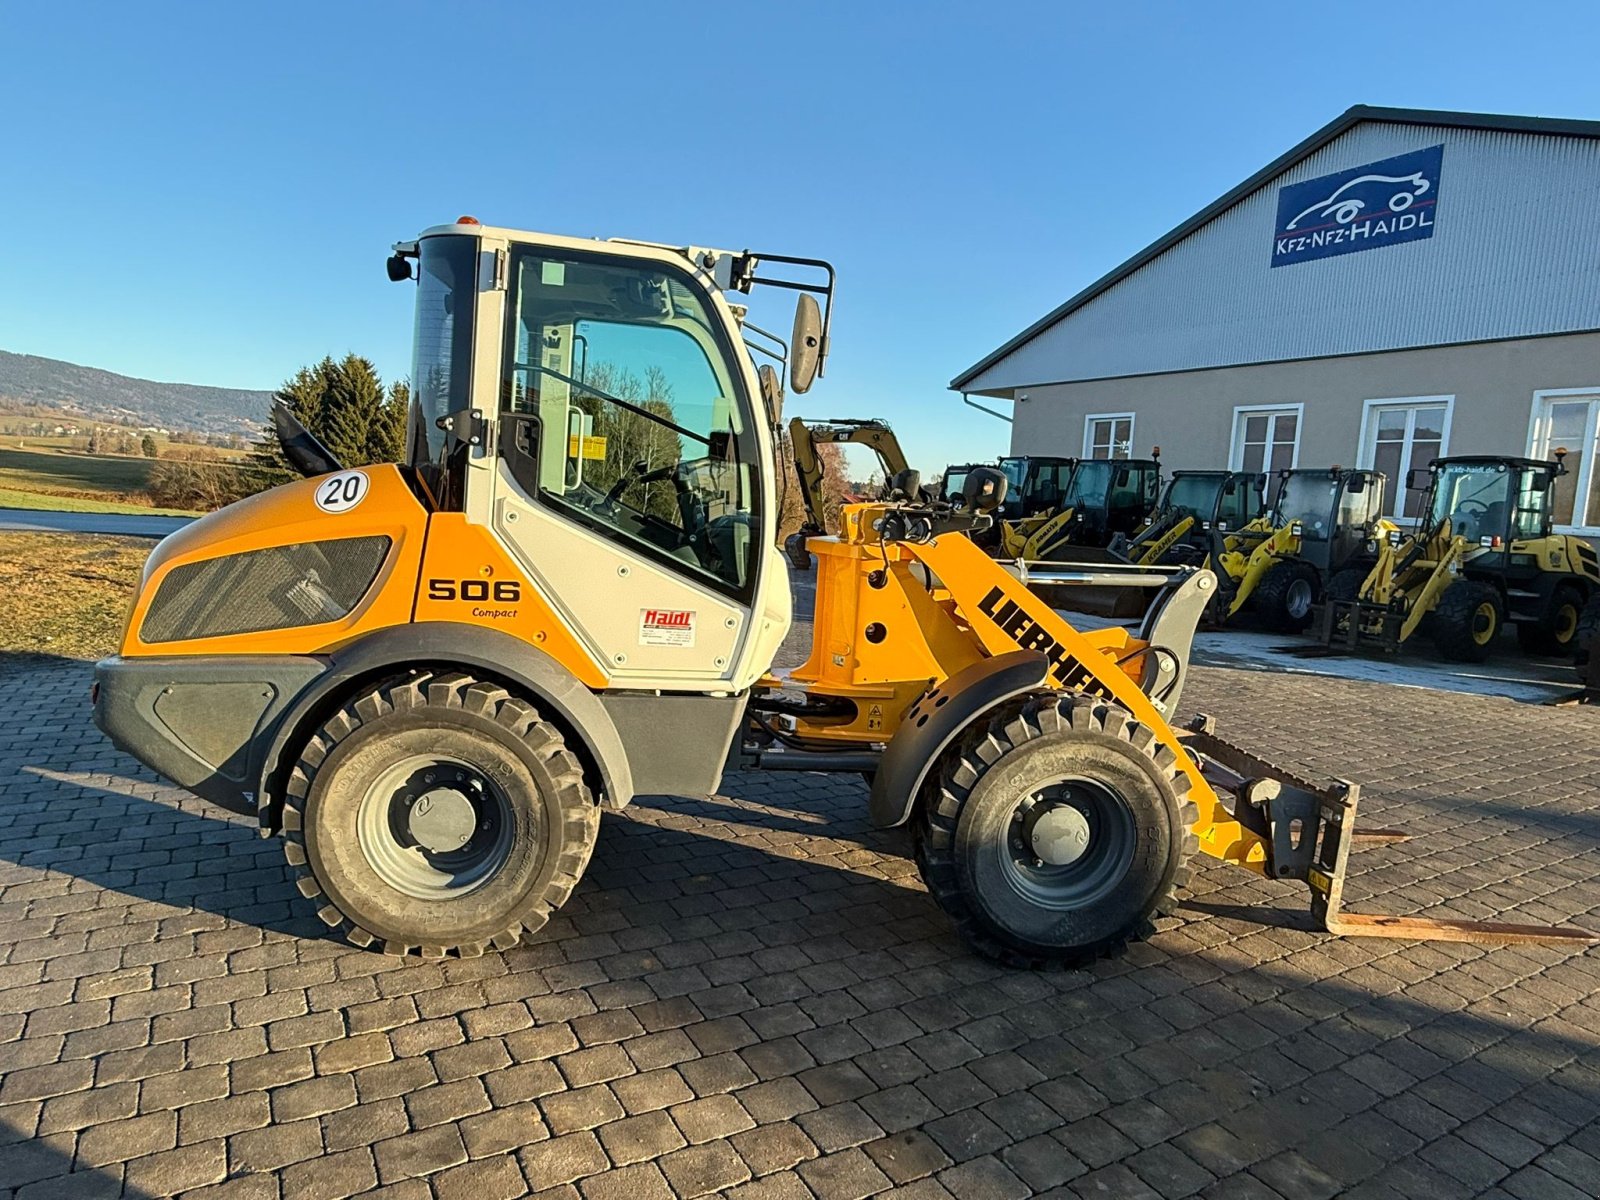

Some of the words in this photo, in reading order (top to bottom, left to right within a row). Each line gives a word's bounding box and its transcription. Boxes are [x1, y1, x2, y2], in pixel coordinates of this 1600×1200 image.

[323, 475, 360, 505] 20
[1147, 531, 1177, 562] KRAMER
[428, 578, 521, 602] 506
[472, 607, 518, 619] Compact
[977, 585, 1135, 716] LIEBHE
